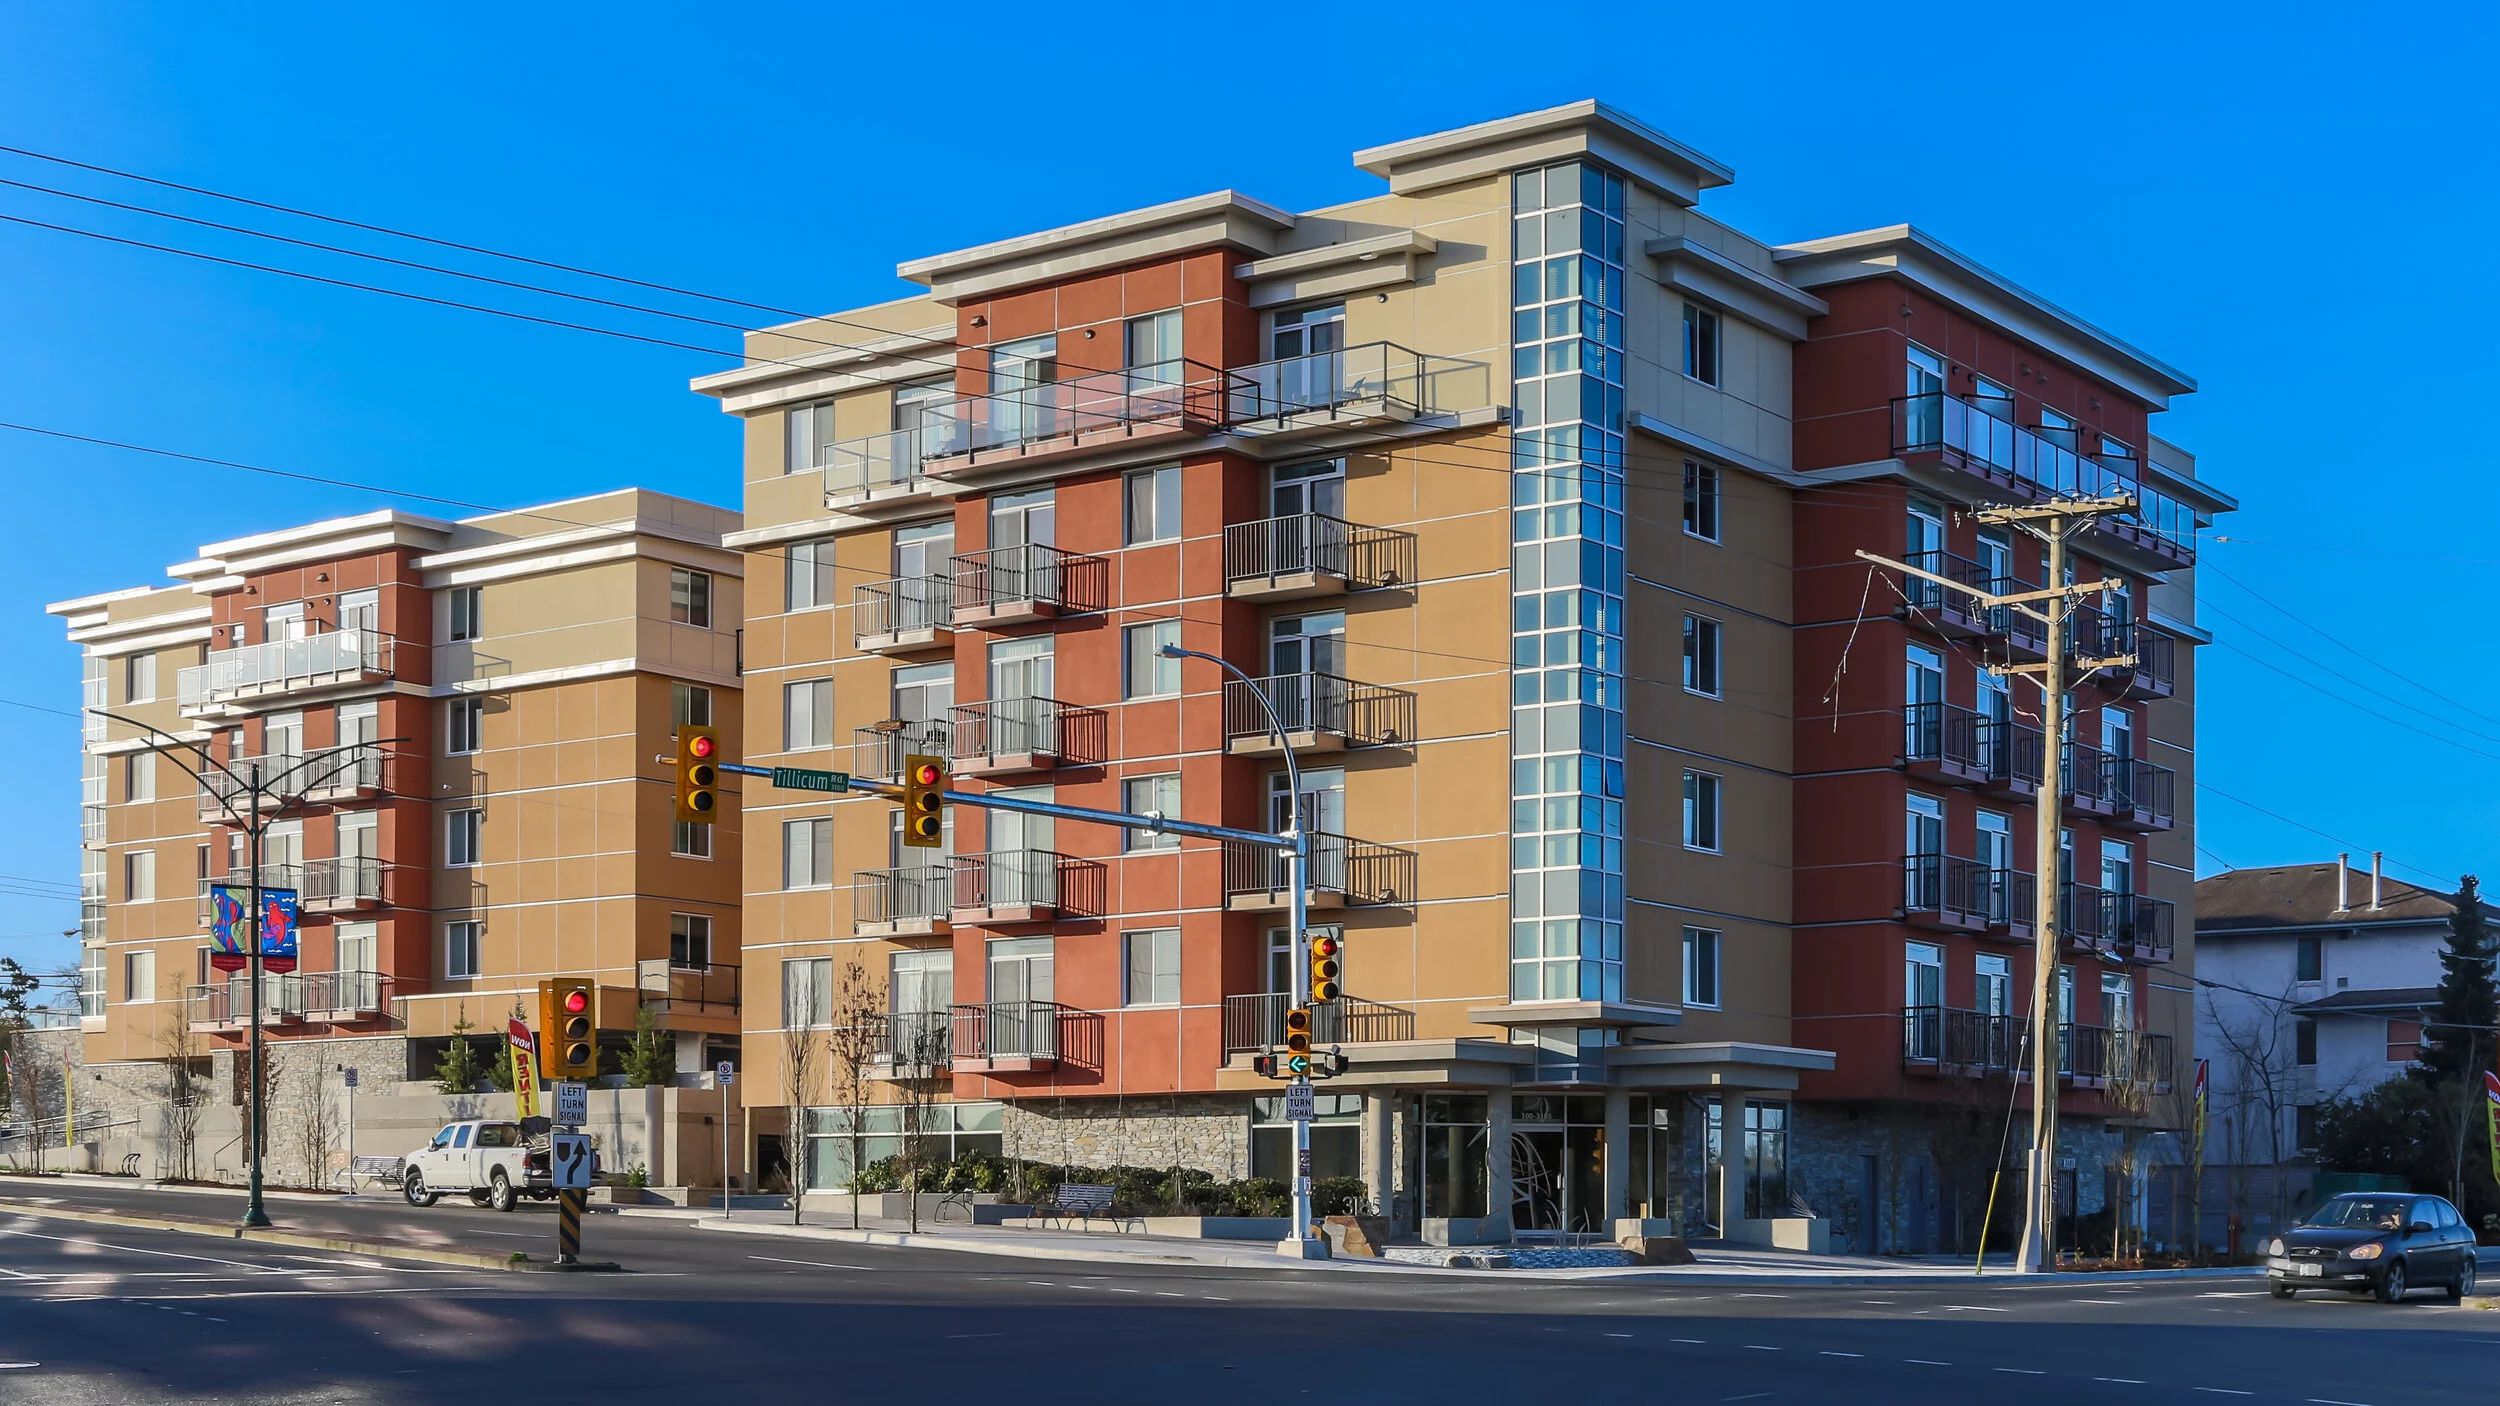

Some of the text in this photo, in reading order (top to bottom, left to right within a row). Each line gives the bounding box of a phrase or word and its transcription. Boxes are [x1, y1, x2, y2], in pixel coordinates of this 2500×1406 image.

[776, 769, 846, 790] Tillicum Rd.
[562, 1086, 582, 1096] LEFT
[1290, 1088, 1309, 1097] LEFT
[561, 1099, 584, 1109] TURN
[1290, 1098, 1311, 1107] TURN
[560, 1111, 585, 1121] SIGNAL
[1288, 1109, 1312, 1118] SIGNAL
[1342, 1195, 1381, 1217] 3185
